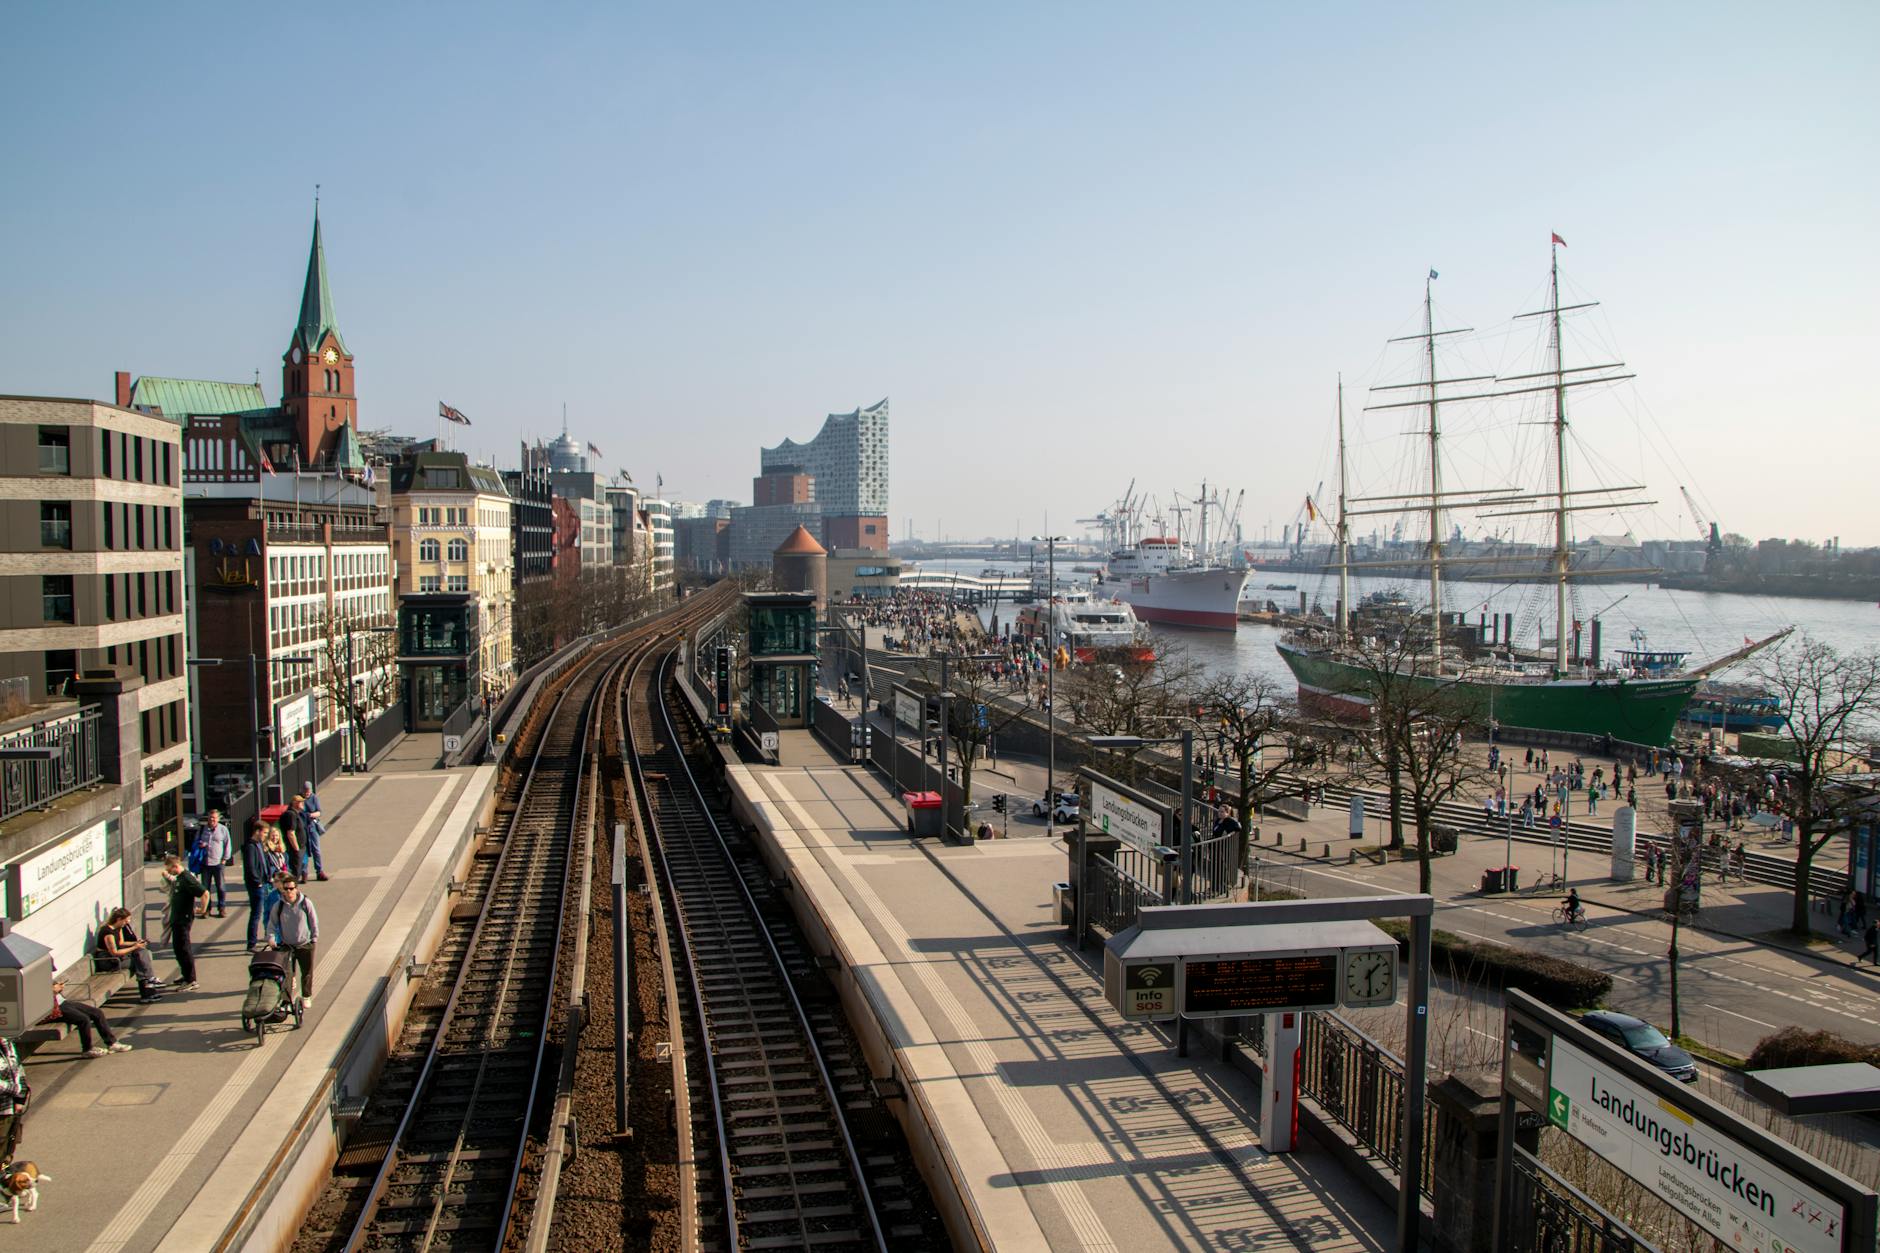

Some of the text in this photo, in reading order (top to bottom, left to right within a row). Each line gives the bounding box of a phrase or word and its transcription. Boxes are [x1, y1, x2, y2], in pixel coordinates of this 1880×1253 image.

[1102, 795, 1148, 831] Landungsbrücken
[1136, 990, 1163, 1001] Info
[1136, 1002, 1163, 1012] SOS
[1581, 1112, 1608, 1137] Hafentor
[1591, 1076, 1776, 1218] Landungsbrücken
[1658, 1164, 1721, 1215] Landungsbrücken
[1658, 1178, 1721, 1230] Helgoländer Allee
